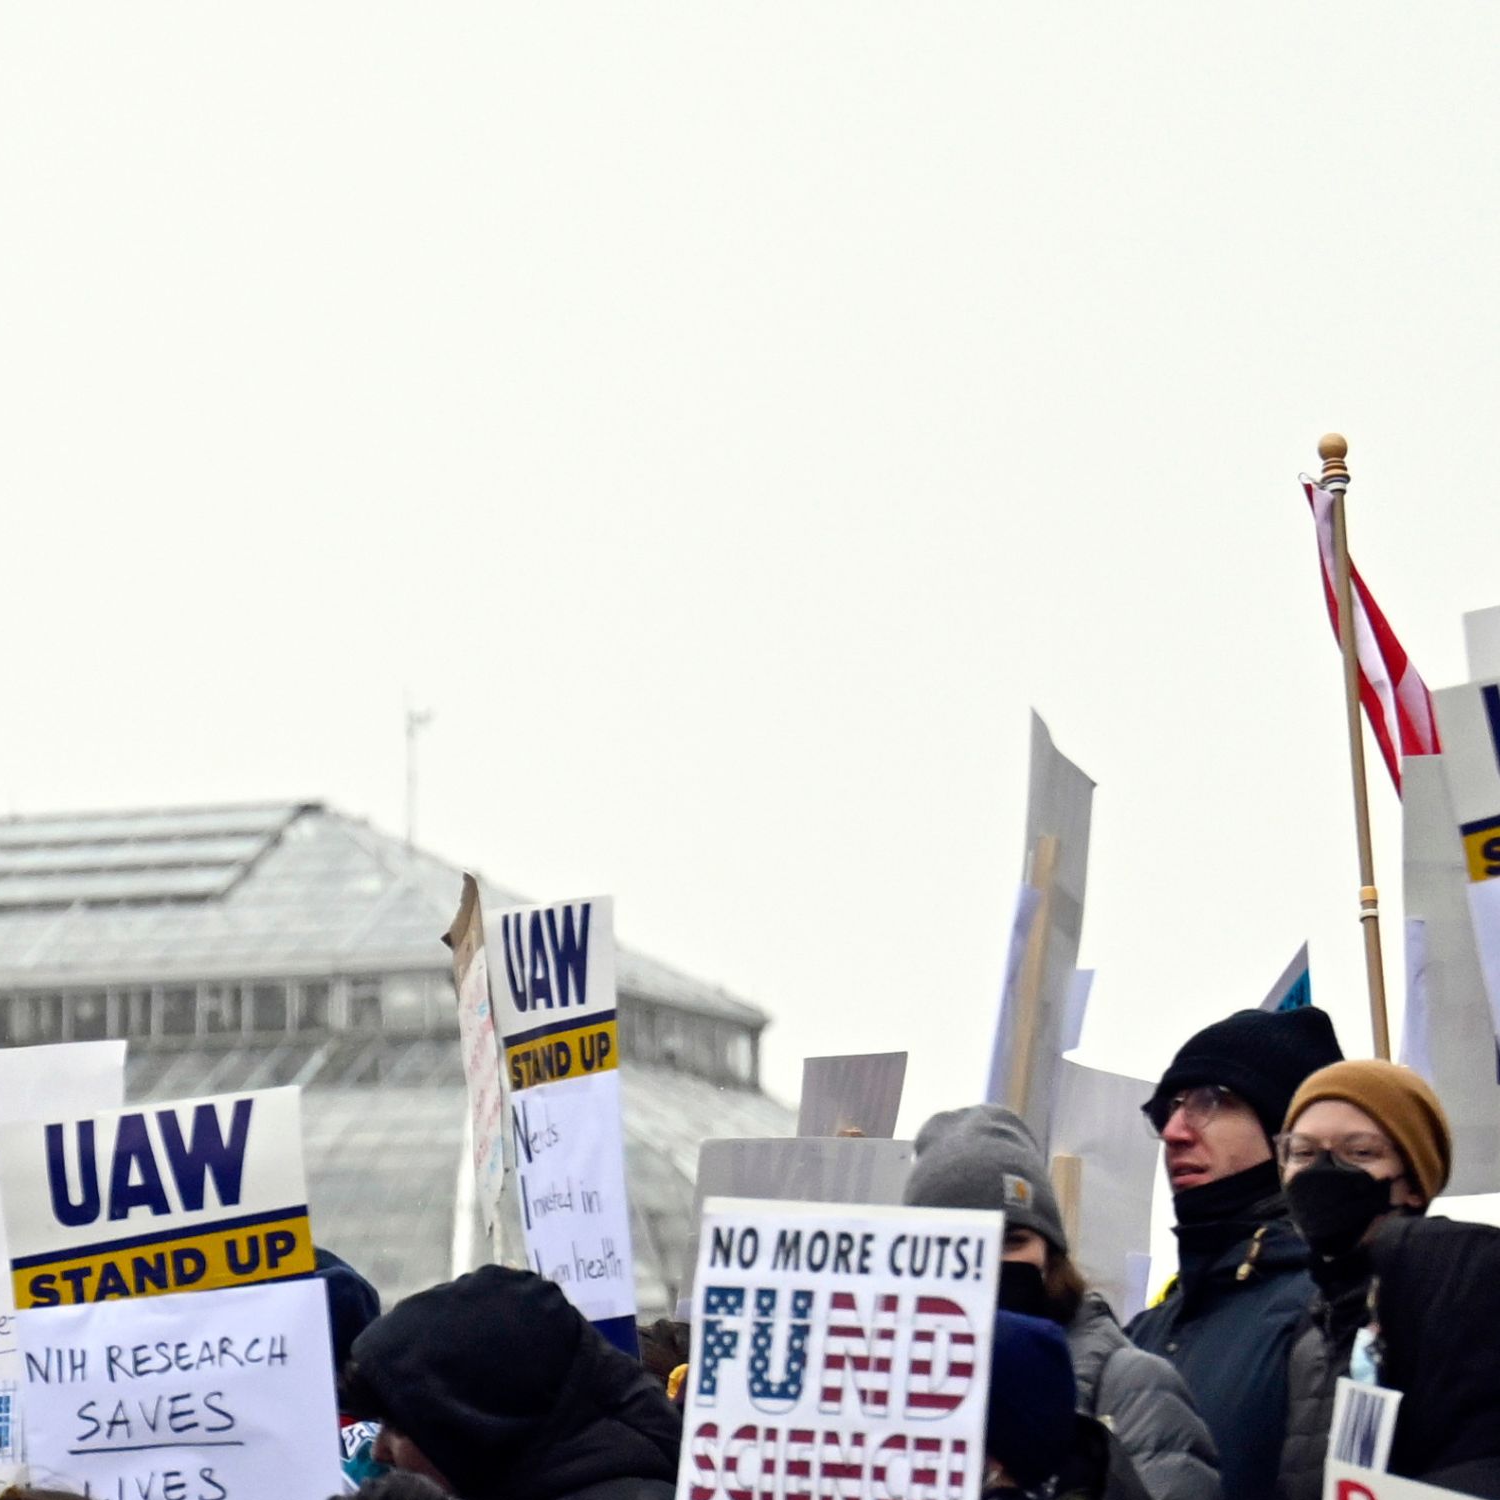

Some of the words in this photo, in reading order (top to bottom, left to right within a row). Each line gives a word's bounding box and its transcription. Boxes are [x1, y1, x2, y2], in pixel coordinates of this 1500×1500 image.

[502, 903, 591, 1013] UAW
[510, 1041, 572, 1090] STAND
[581, 1031, 611, 1070] UP
[45, 1098, 254, 1228] UAW
[29, 1248, 207, 1309] STAND
[225, 1230, 297, 1275] UP
[709, 1226, 760, 1269] NO
[771, 1229, 875, 1275] MORE
[888, 1234, 986, 1282] CUTS!
[25, 1345, 88, 1385] NIH
[107, 1334, 289, 1382] RESEARCH
[695, 1286, 977, 1421] FUND
[77, 1391, 238, 1441] SAVES
